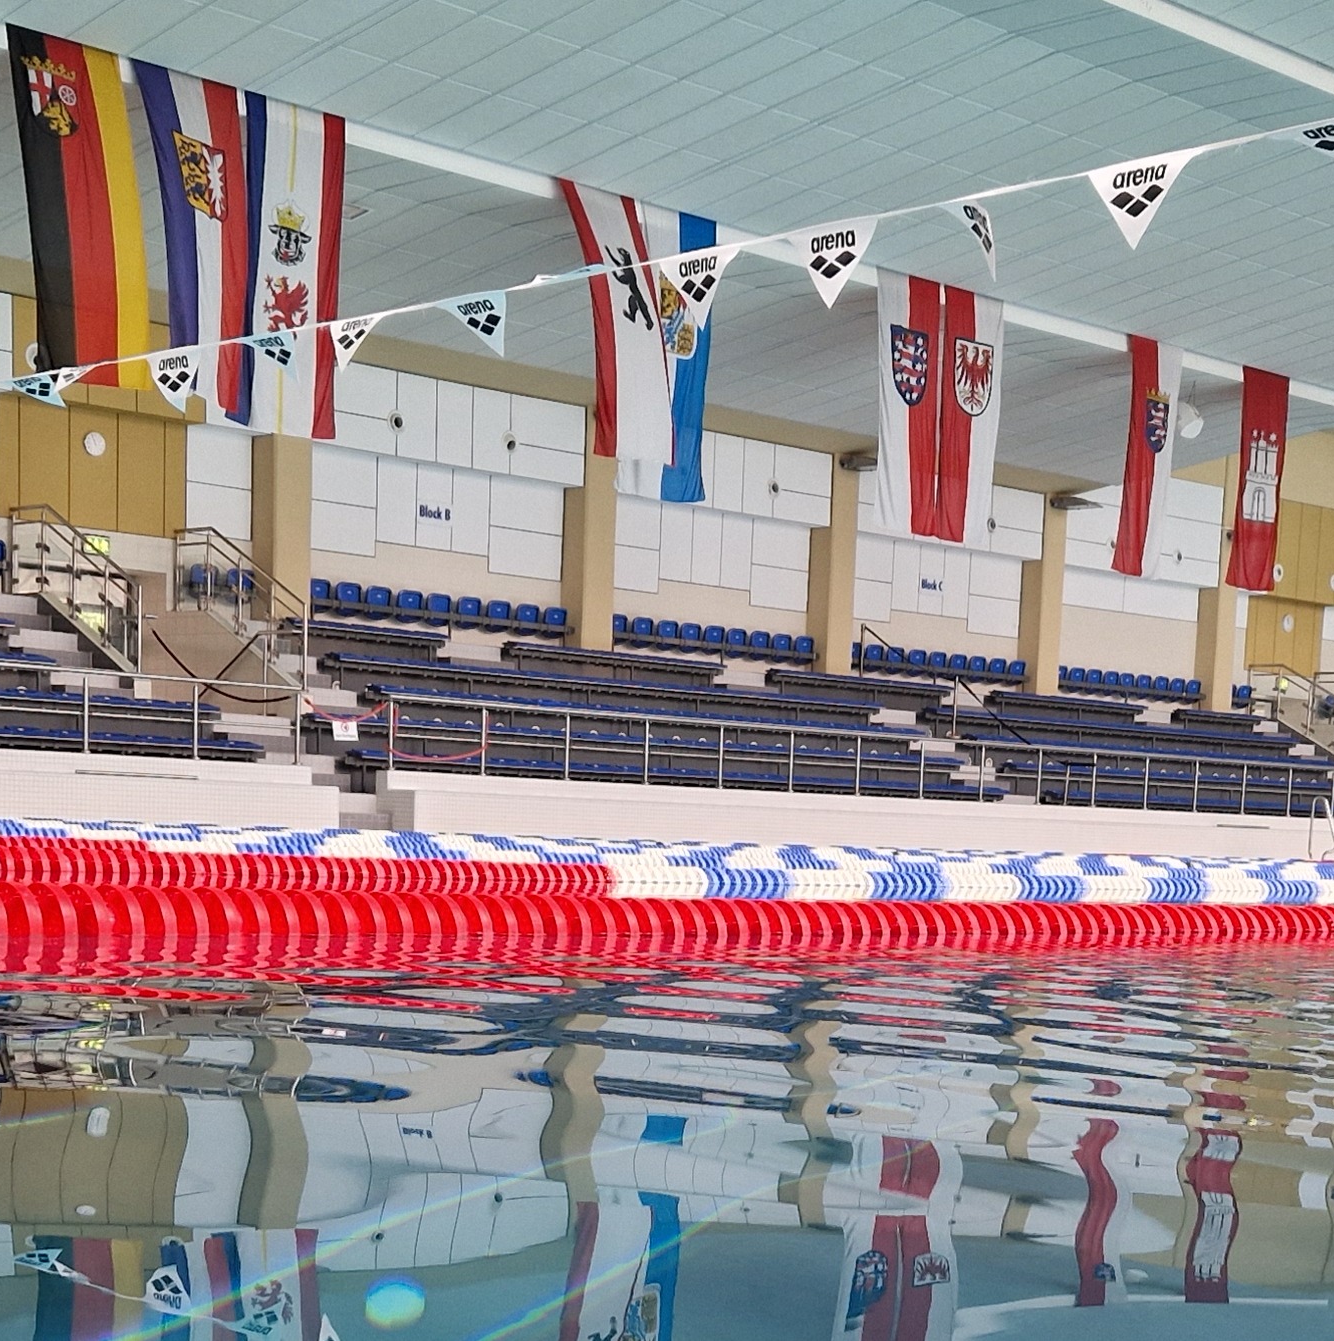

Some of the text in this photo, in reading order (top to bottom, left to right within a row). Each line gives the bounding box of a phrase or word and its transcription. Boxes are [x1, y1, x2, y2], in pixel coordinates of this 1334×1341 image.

[1112, 163, 1168, 190] arena
[811, 229, 856, 254] arena
[679, 255, 718, 278] arena
[456, 299, 495, 316] arena
[158, 355, 189, 371] arena
[419, 504, 451, 521] Block B
[921, 578, 937, 591] Block
